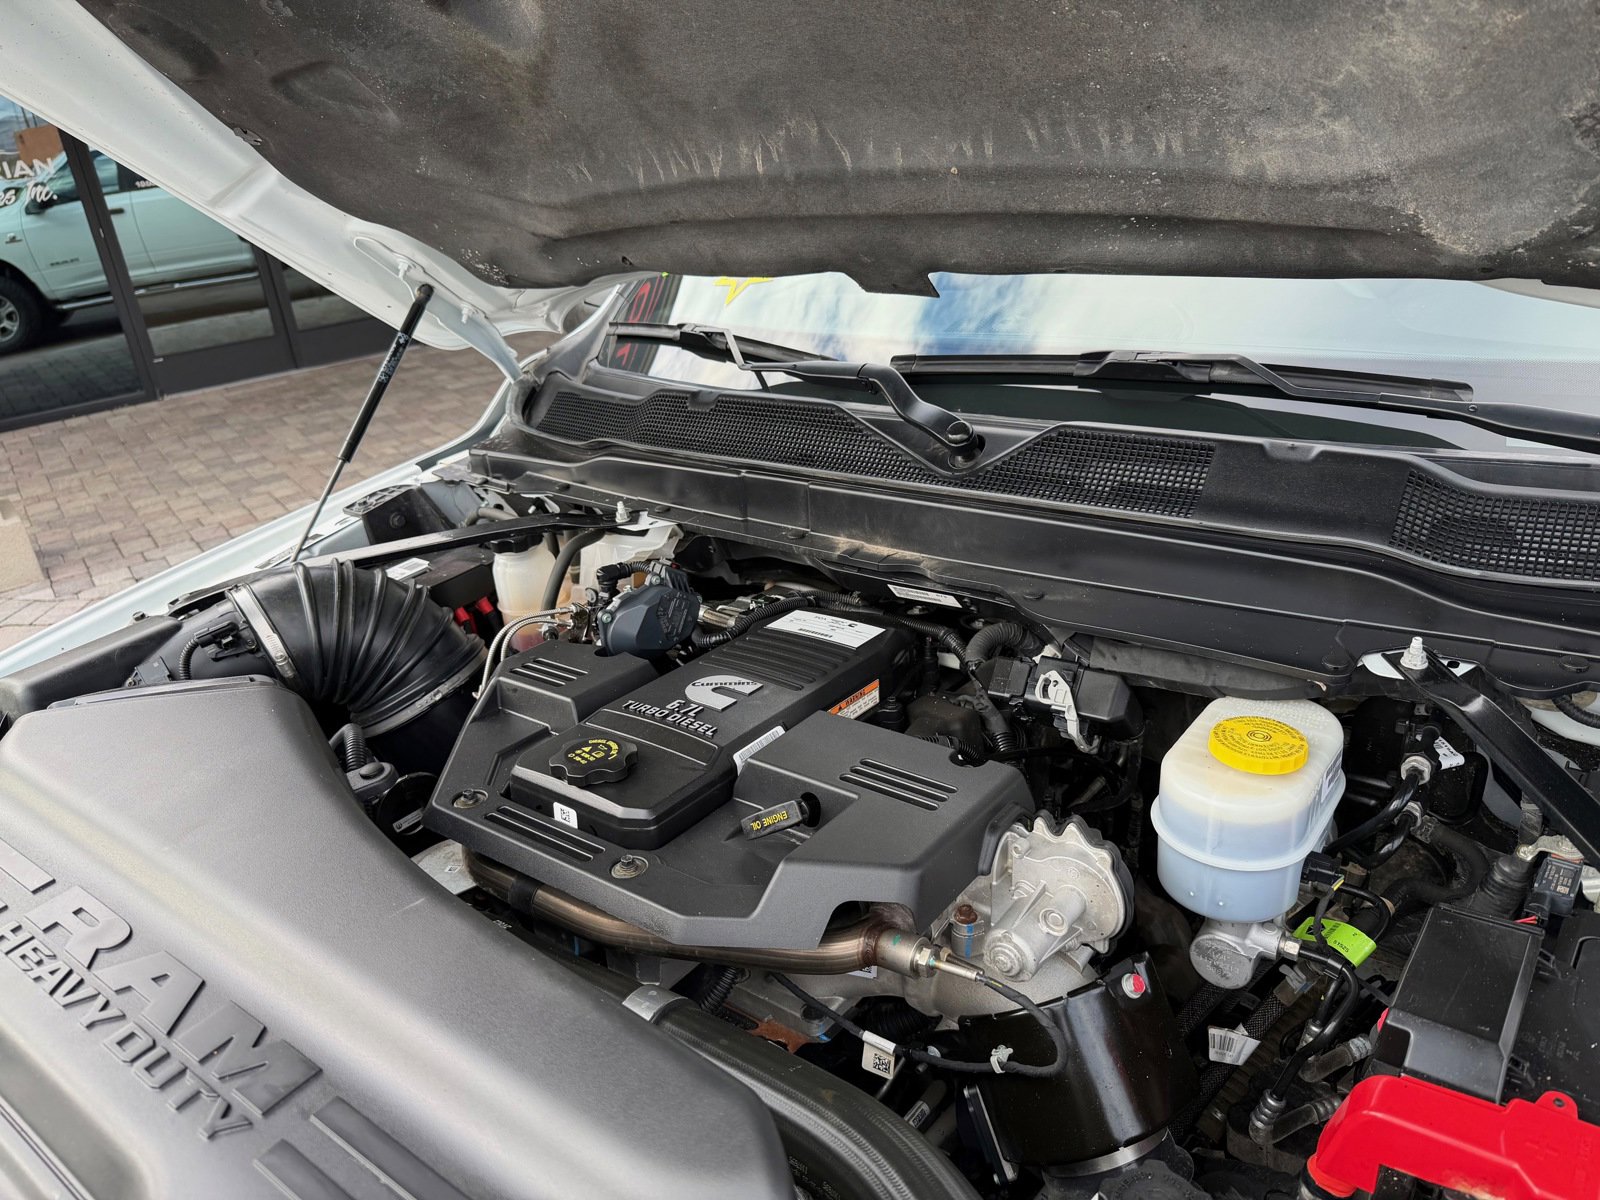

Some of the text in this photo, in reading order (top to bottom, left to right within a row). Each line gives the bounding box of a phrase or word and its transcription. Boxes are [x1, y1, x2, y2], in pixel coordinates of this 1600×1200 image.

[0, 157, 54, 179] IAN
[25, 180, 58, 205] Inc.
[622, 700, 719, 739] TURBO DIESEL
[665, 699, 705, 717] 6.7L
[750, 810, 788, 831] ENGINE OIL
[23, 885, 323, 1119] RAM
[0, 920, 253, 1140] HEAVY DUTY
